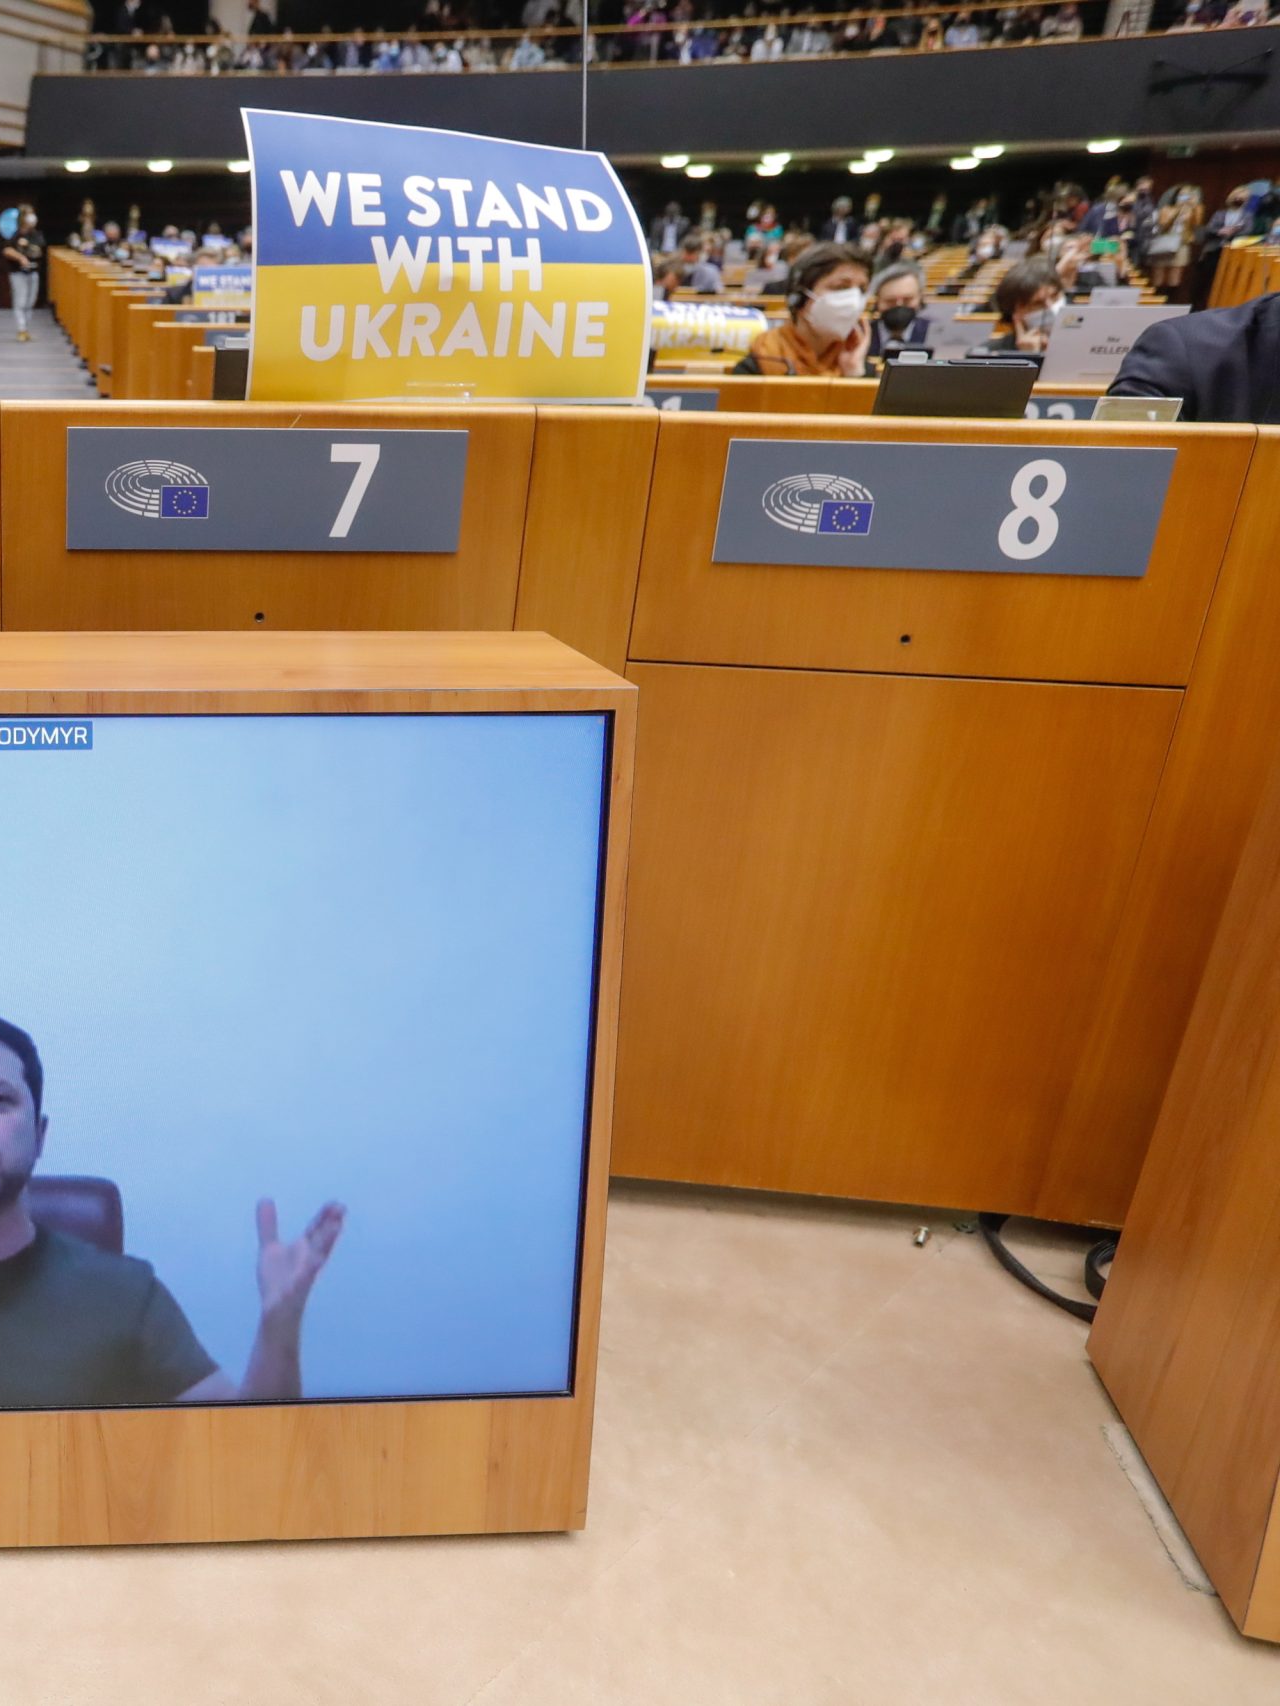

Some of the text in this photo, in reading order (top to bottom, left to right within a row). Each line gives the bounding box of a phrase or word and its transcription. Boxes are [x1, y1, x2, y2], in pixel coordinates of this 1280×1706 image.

[280, 169, 613, 233] WE STAND
[370, 235, 543, 293] WITH
[300, 302, 609, 359] UKRAINE
[328, 443, 381, 538] 7
[997, 459, 1067, 560] 8
